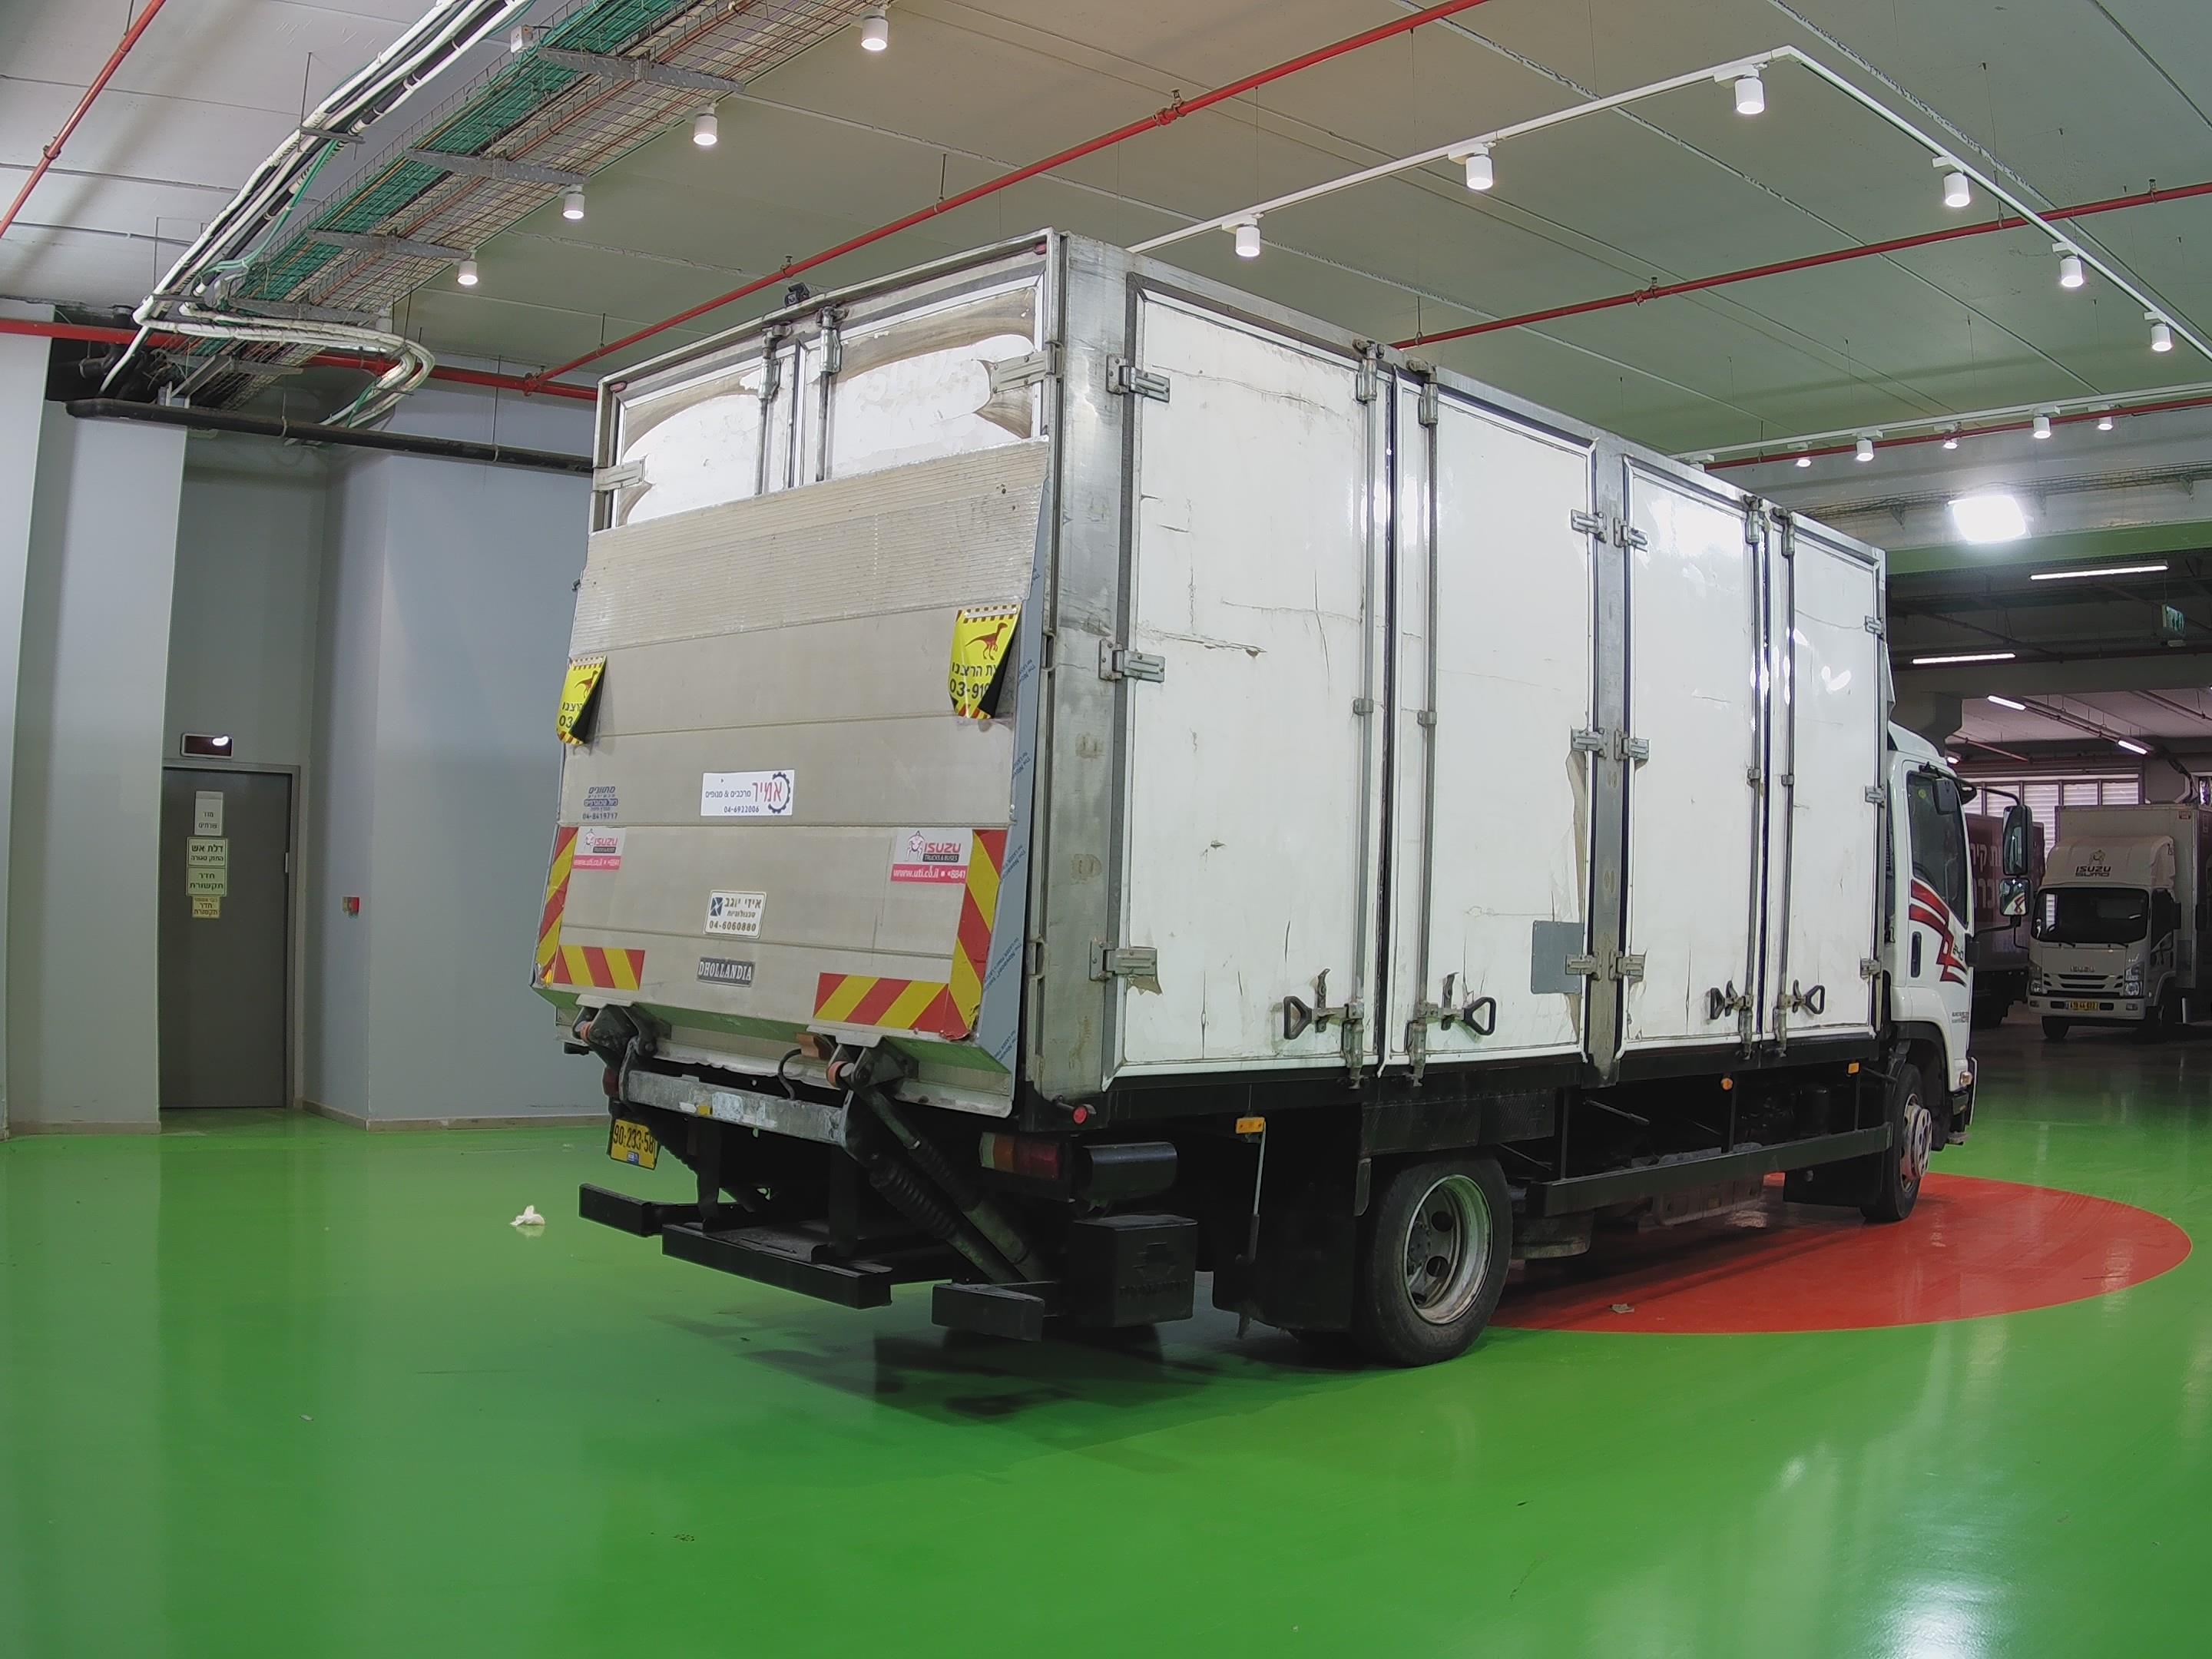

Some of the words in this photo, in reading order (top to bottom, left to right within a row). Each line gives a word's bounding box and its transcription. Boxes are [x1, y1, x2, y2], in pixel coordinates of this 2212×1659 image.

[752, 781, 782, 802] אמיר
[724, 805, 759, 813] 04-6922006
[207, 844, 224, 853] דלת
[924, 843, 961, 853] ISUZU
[893, 868, 939, 878] www.uti.co.il
[190, 882, 224, 891] תקשורת
[709, 920, 757, 932] 04-6060880
[698, 961, 752, 981] DHOLLANDIA
